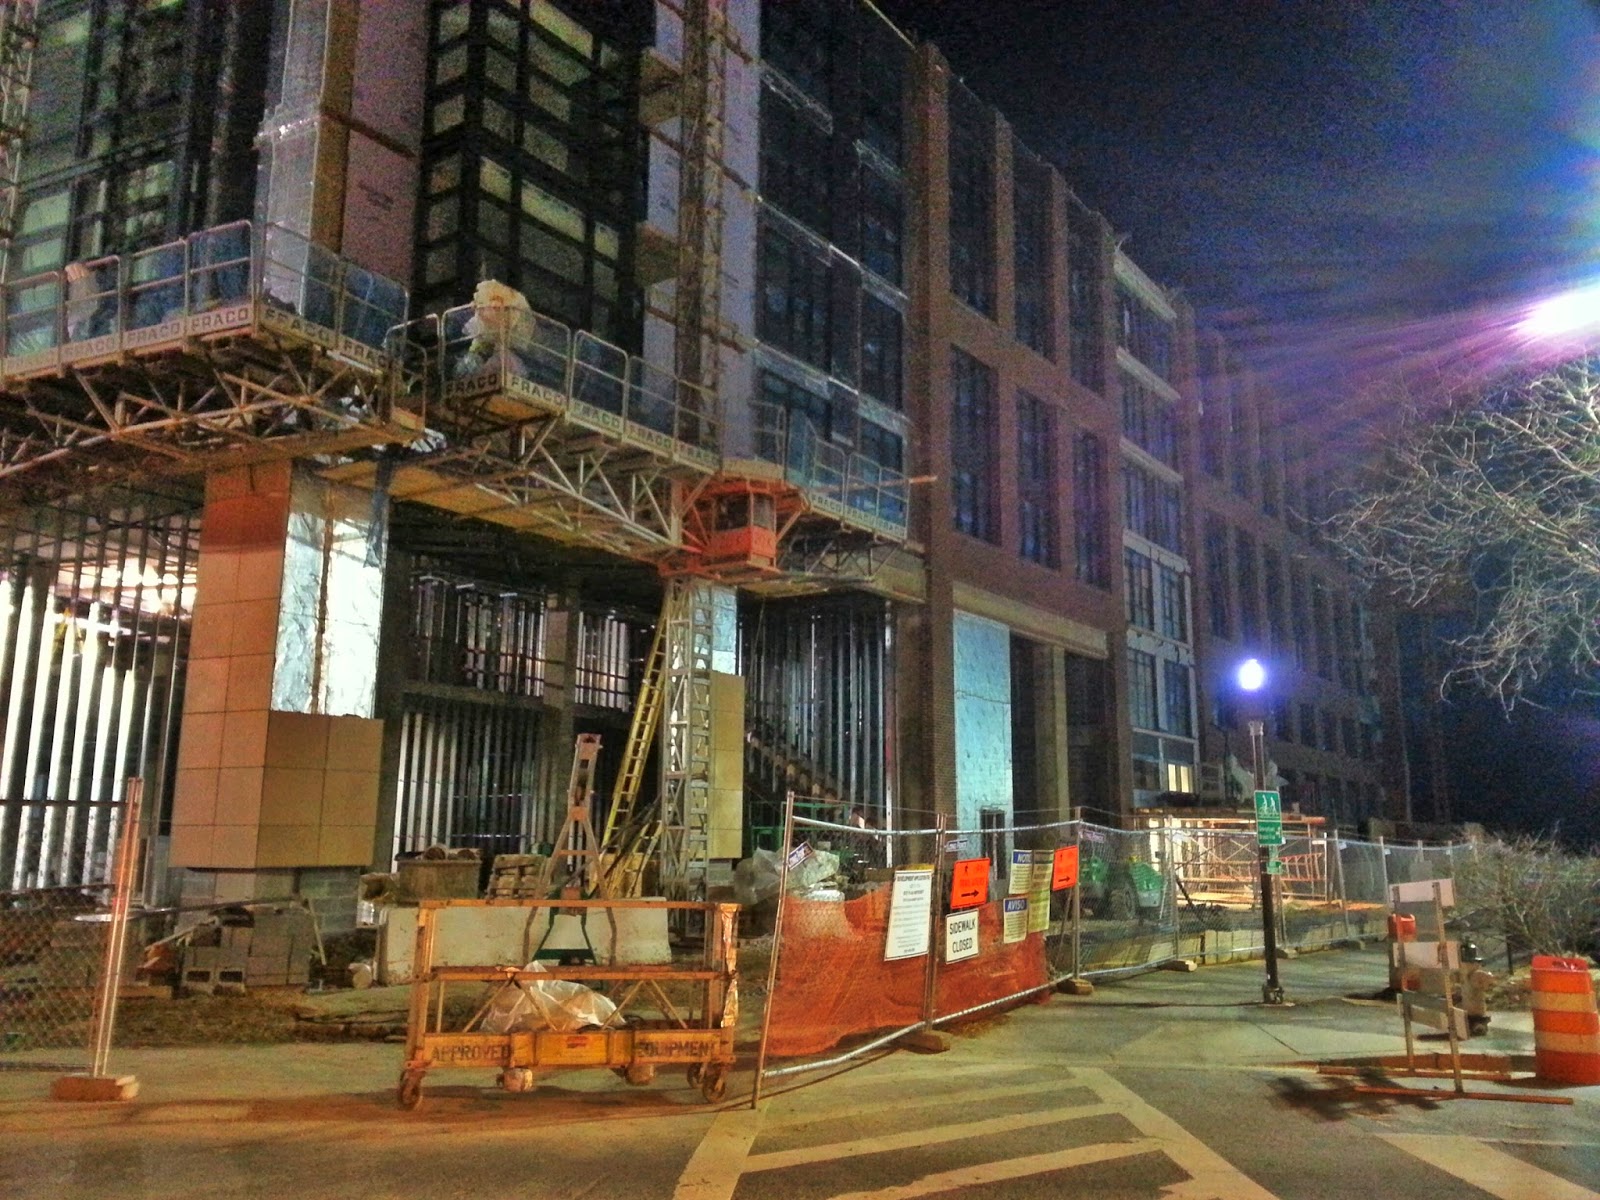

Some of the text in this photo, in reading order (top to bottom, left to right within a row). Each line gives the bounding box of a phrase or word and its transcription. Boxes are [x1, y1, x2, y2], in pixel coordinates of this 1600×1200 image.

[191, 307, 249, 331] FRACO
[265, 308, 330, 342] FRACO
[127, 322, 180, 341] FRACO
[446, 373, 498, 394] FRACO
[512, 376, 563, 405] FRACO
[574, 401, 620, 427] FRACO
[1007, 899, 1025, 911] AVISO
[949, 918, 976, 935] SIDEWALK
[952, 937, 973, 953] CLOSED
[431, 1043, 511, 1061] APPROVED
